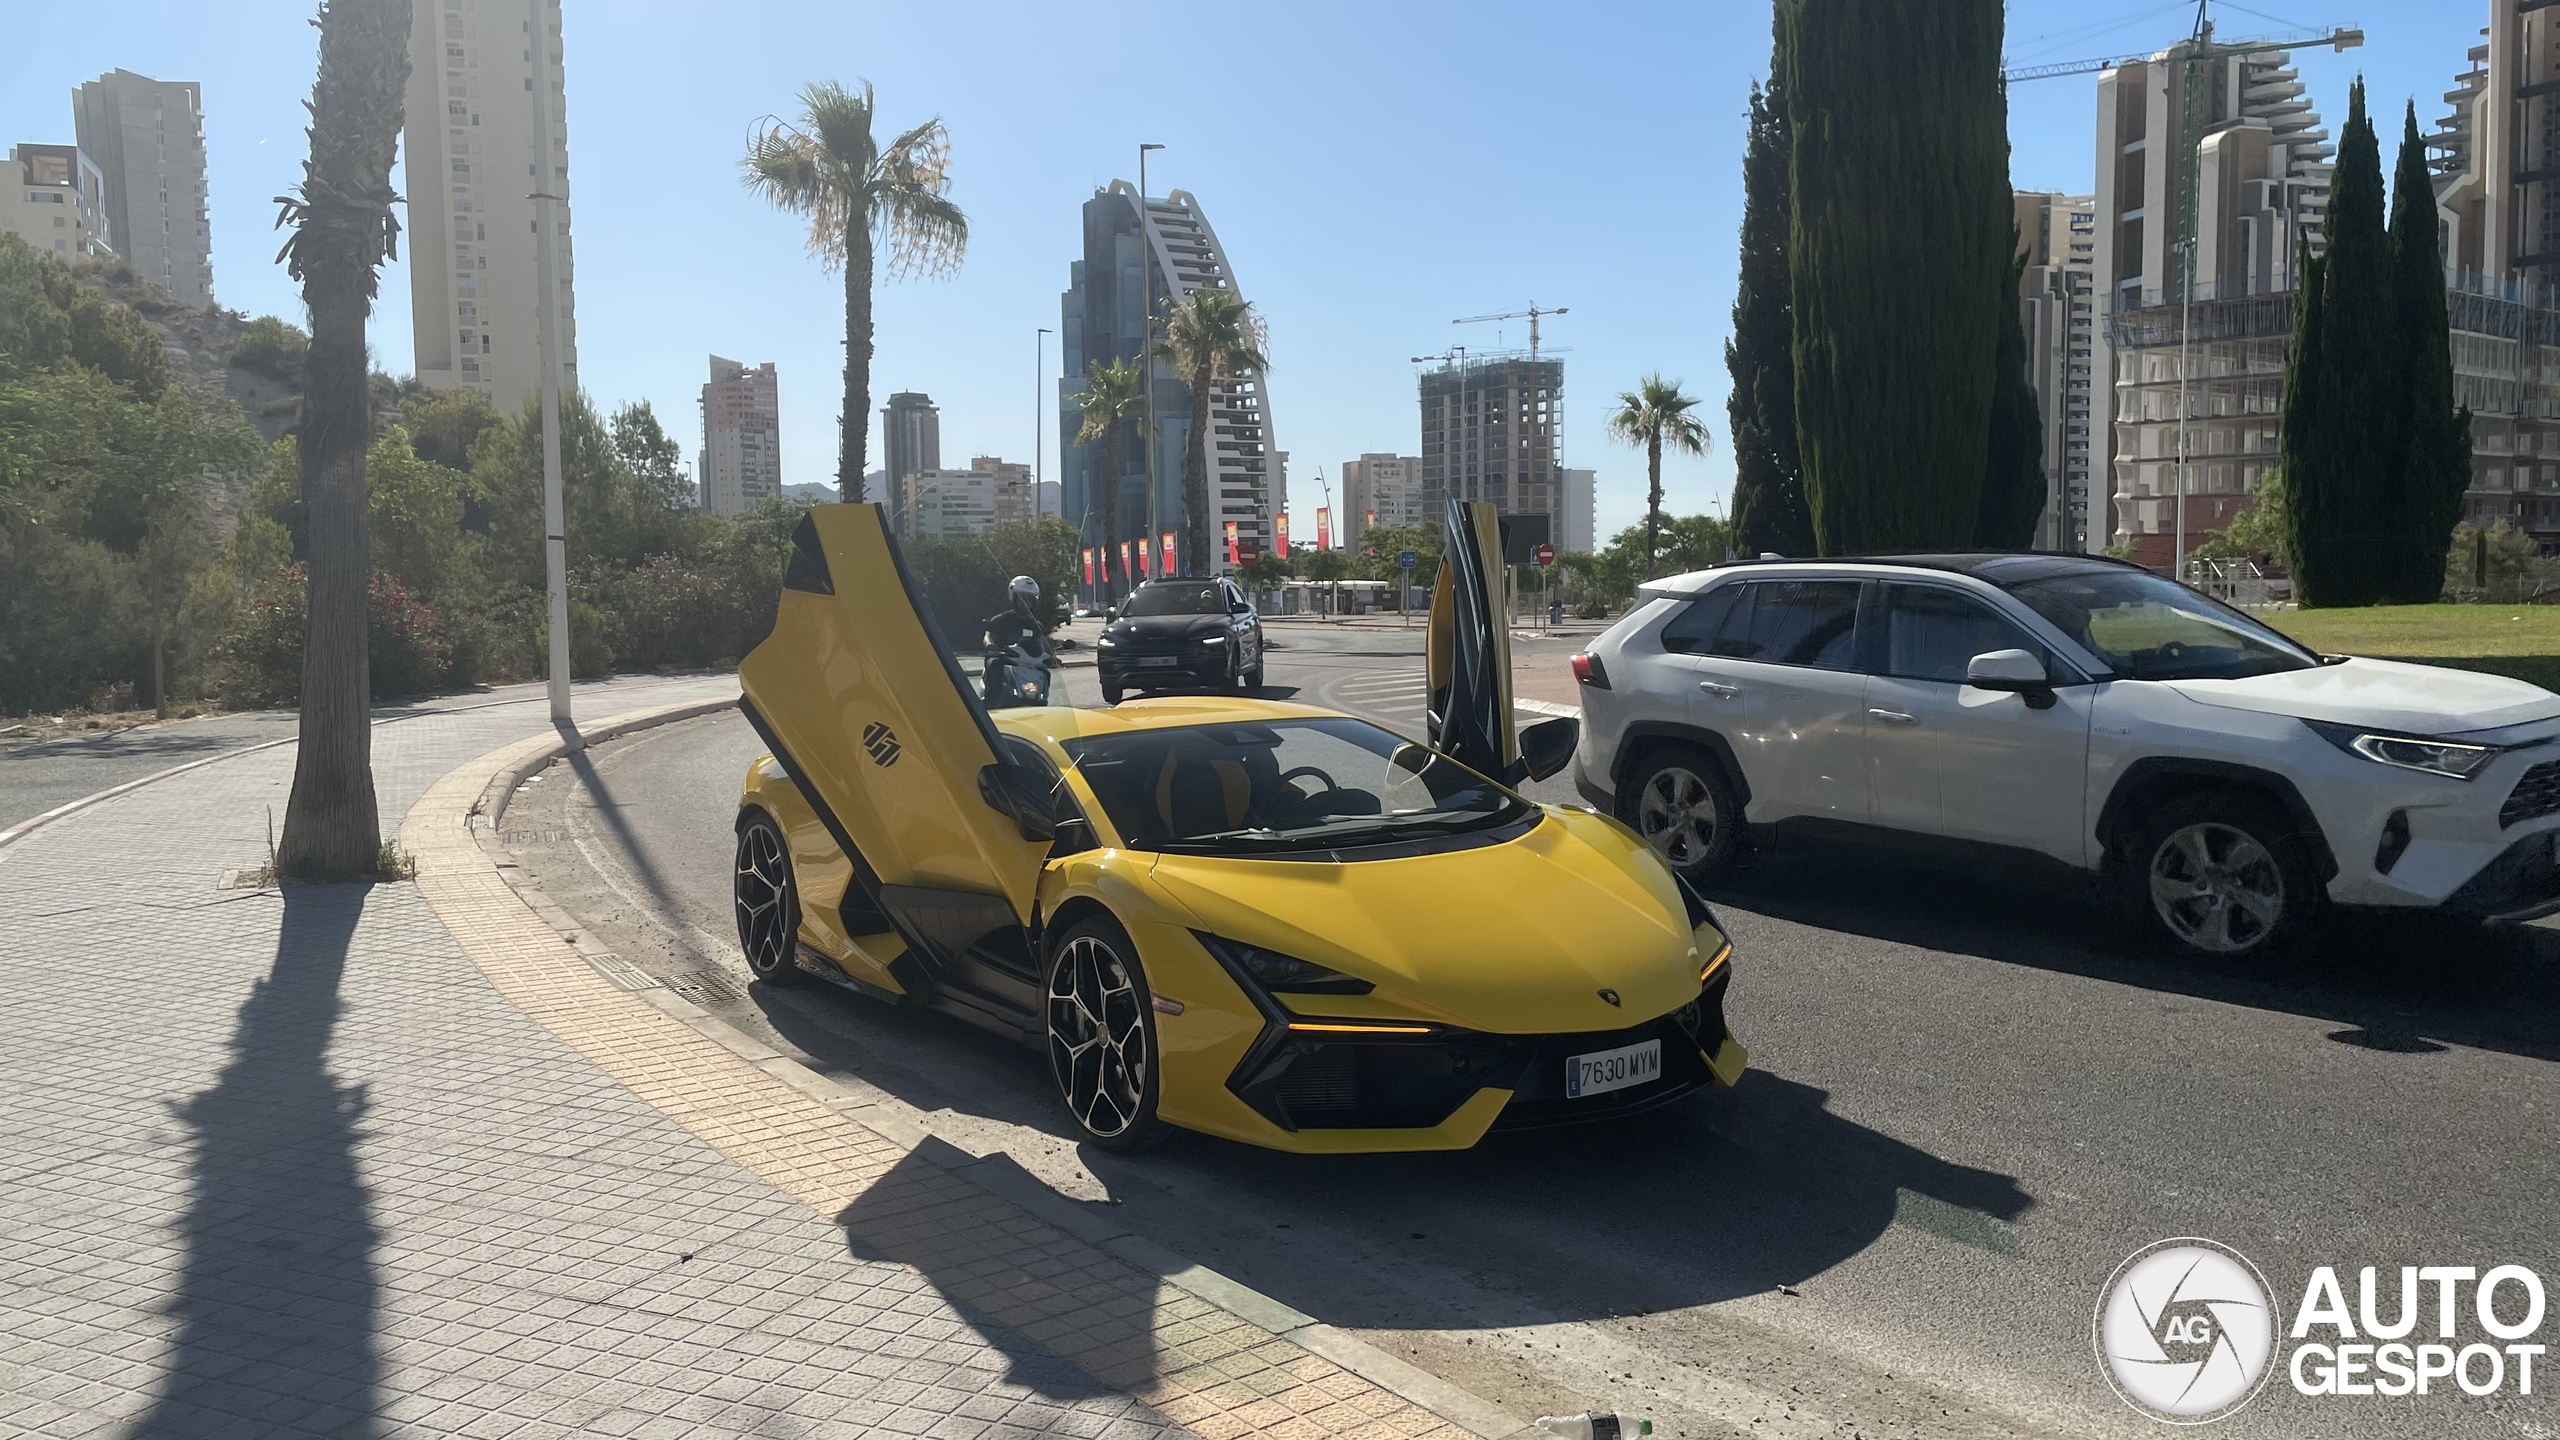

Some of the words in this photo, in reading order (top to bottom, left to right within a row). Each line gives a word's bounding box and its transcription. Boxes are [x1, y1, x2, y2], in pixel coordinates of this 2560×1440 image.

[1571, 1081, 1577, 1090] E
[1582, 1057, 1625, 1087] 7630
[1630, 1048, 1658, 1077] MYM
